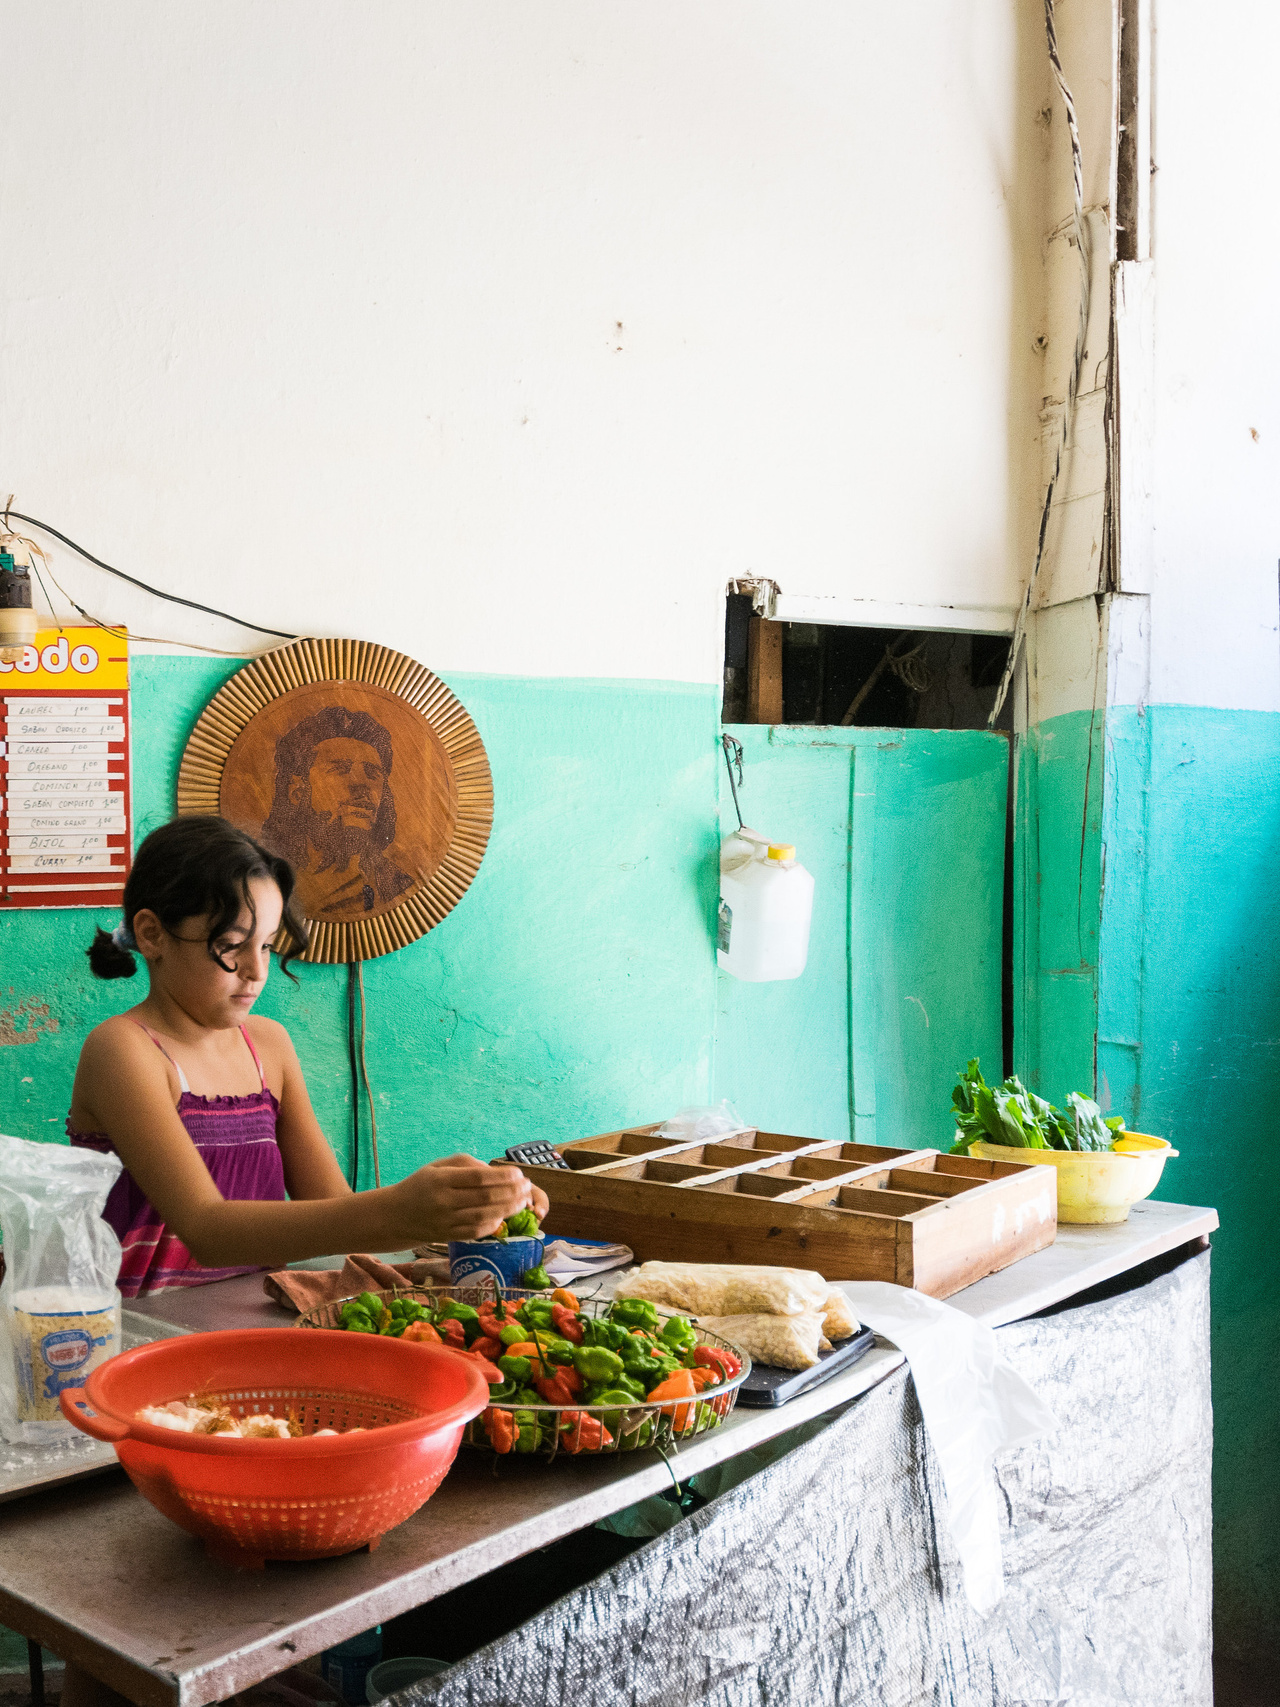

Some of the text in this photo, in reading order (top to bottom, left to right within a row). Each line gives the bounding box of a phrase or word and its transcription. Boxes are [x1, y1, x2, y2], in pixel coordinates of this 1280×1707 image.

[19, 706, 53, 715] LAUREL
[17, 745, 49, 754] CANELA
[27, 762, 68, 773] OREGANO
[29, 836, 65, 849] BIJOL
